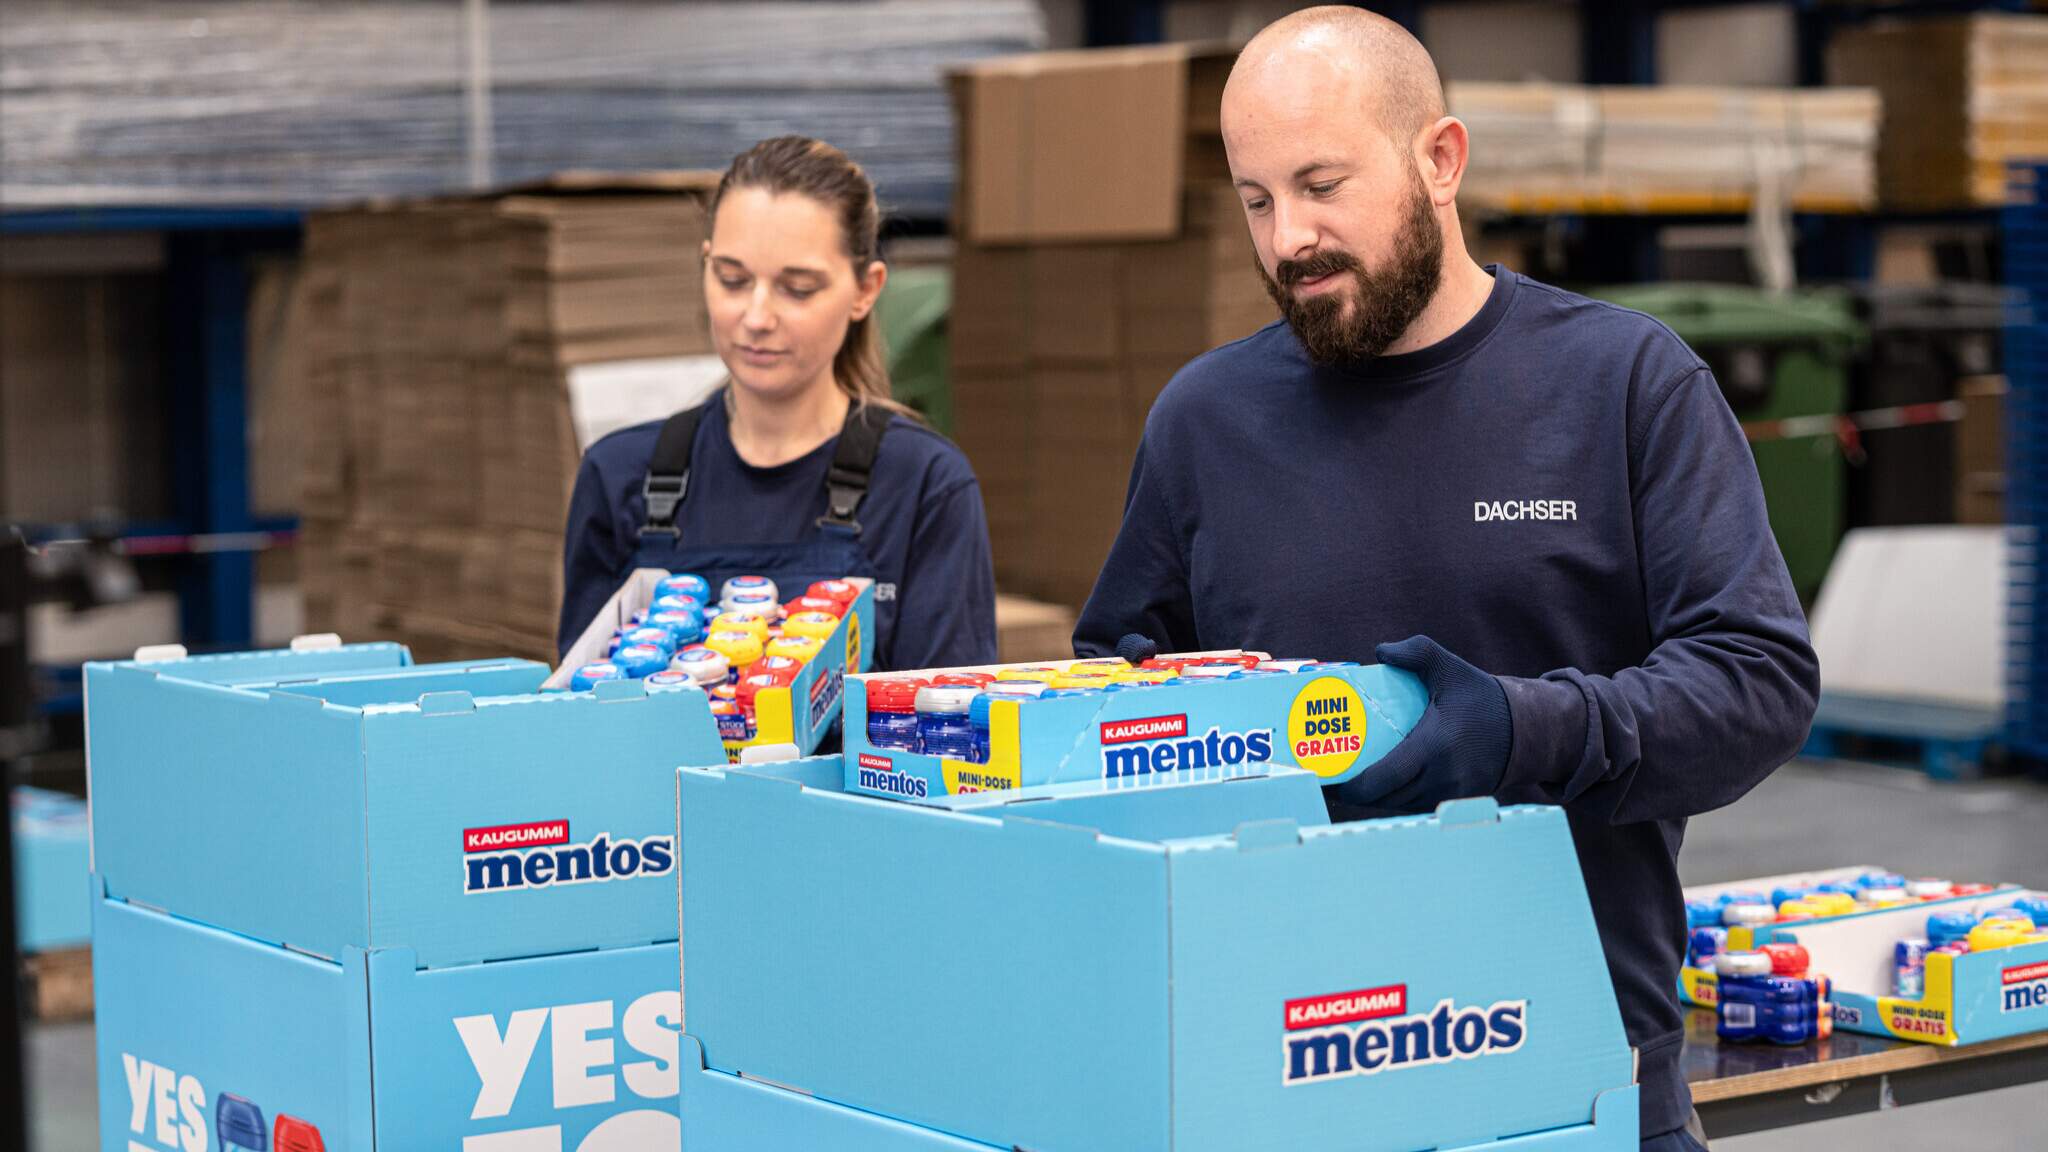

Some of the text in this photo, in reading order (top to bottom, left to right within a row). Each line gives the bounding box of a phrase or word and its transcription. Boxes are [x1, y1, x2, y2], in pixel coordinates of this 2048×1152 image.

[1474, 499, 1578, 522] DACHSER
[1306, 696, 1348, 716] MINI
[1104, 719, 1182, 740] KAUGUMMI
[1305, 717, 1350, 737] DOSE
[1104, 728, 1272, 779] mentos
[1295, 735, 1361, 758] GRATIS
[859, 767, 927, 798] mentos
[957, 771, 1012, 790] MINI-DOSE
[467, 824, 564, 848] KAUGUMMI
[466, 836, 673, 891] mentos
[1289, 991, 1402, 1024] KAUGUMMI
[1892, 1016, 1946, 1036] GRATIS
[1287, 1003, 1523, 1081] mentos
[452, 990, 681, 1121] YES
[121, 1052, 208, 1151] YES
